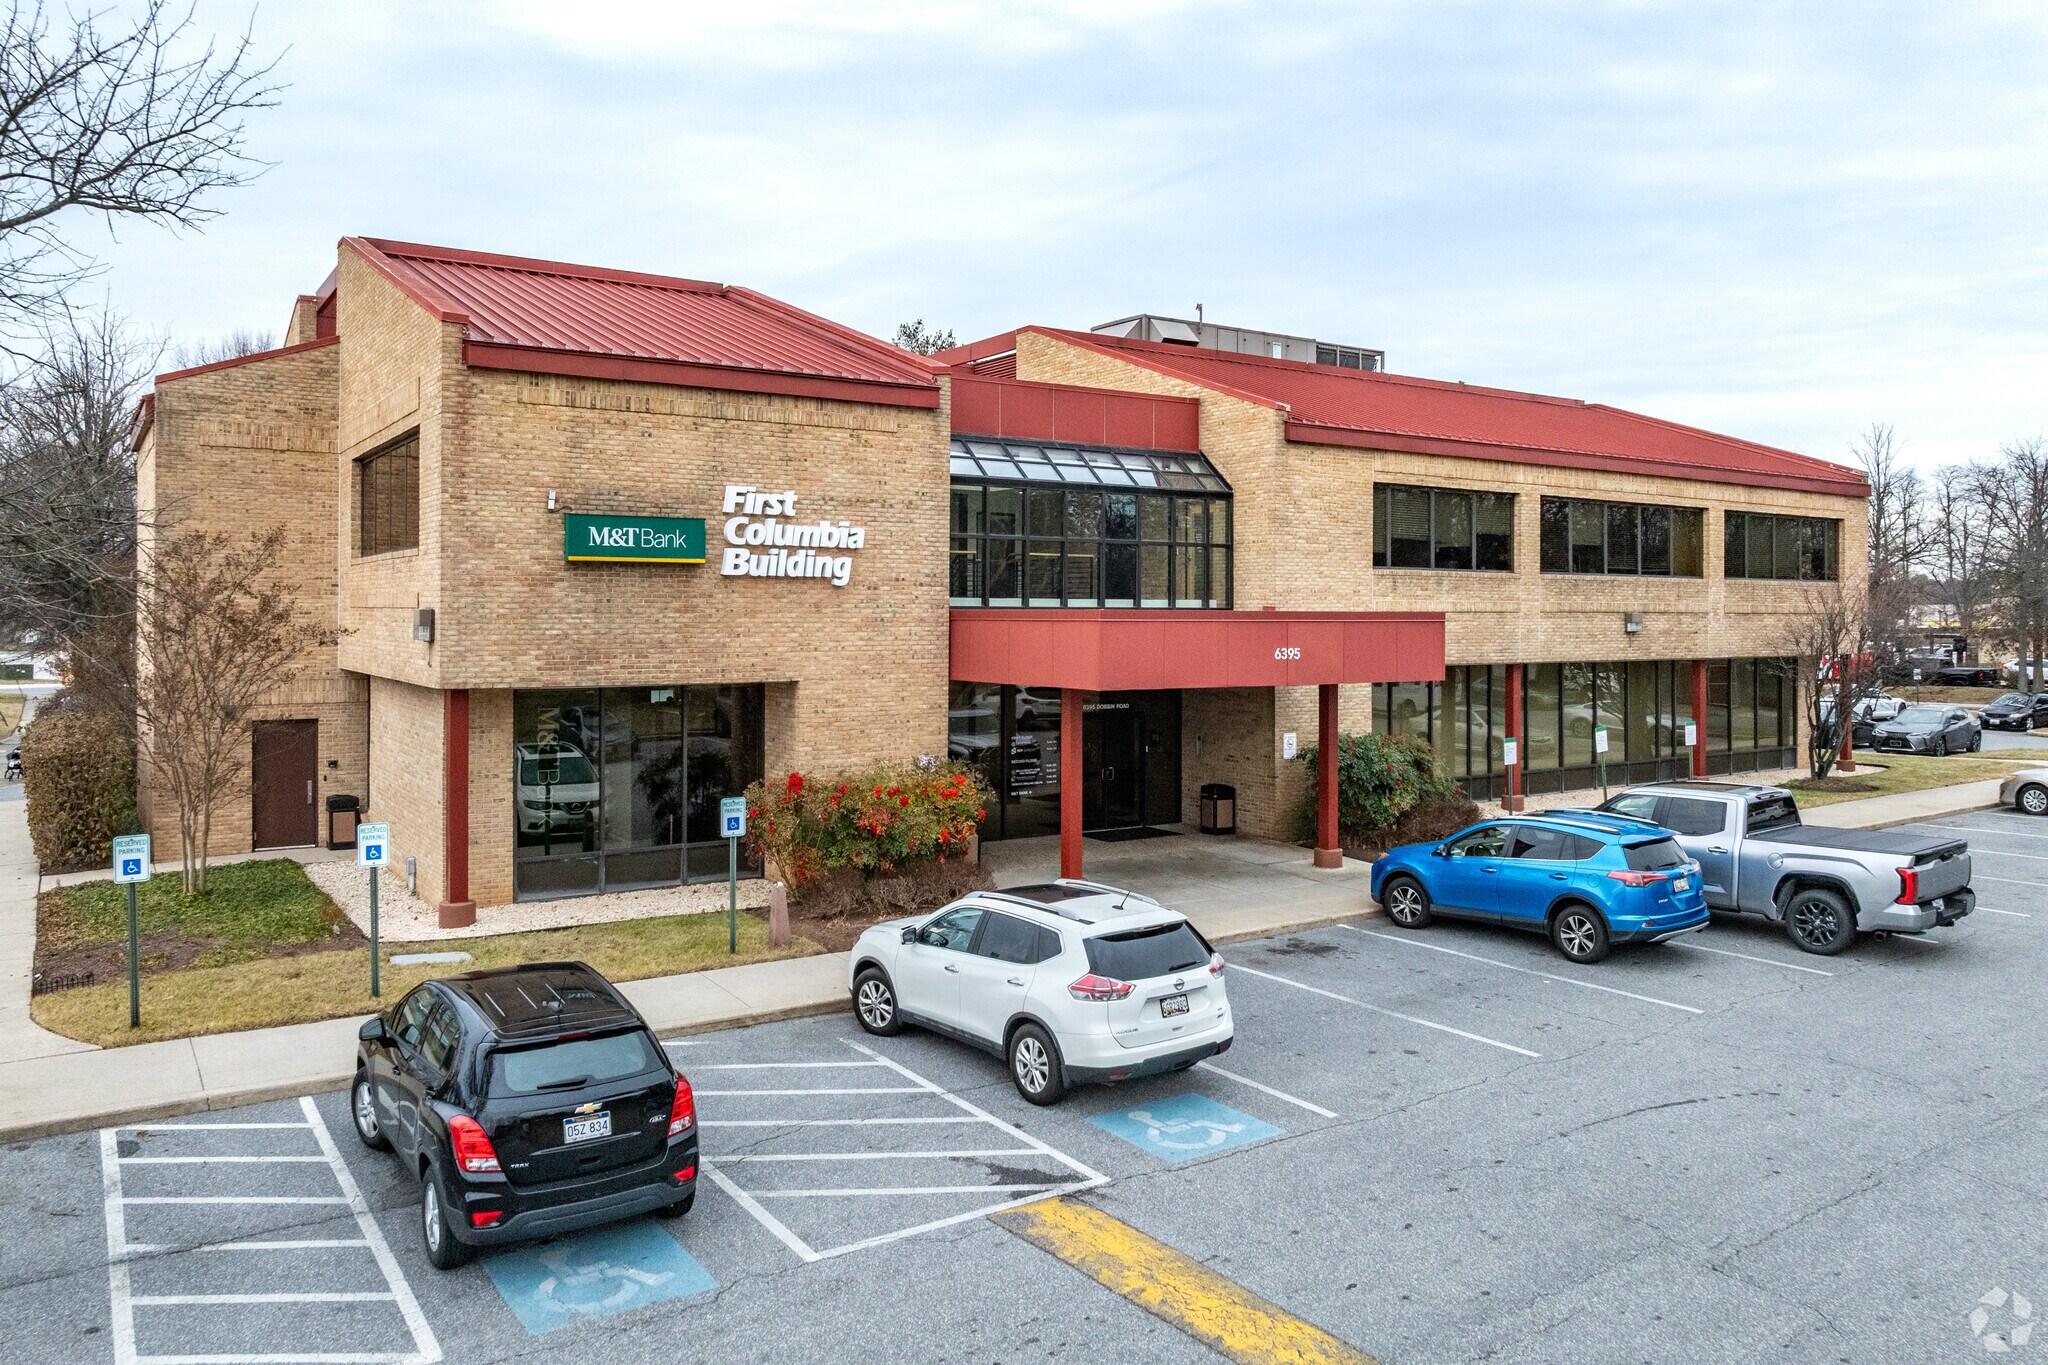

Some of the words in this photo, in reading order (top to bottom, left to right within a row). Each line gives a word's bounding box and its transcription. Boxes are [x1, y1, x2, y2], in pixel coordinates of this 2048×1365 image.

[722, 485, 798, 516] First
[588, 526, 639, 547] M&T
[641, 528, 687, 548] Bank
[723, 516, 865, 549] Columbia
[720, 547, 853, 587] Building
[1274, 647, 1301, 660] 6395
[537, 707, 561, 766] M&T
[360, 826, 387, 834] RESERVED
[116, 839, 147, 847] RESERVED
[118, 847, 146, 855] PARKING
[589, 1120, 608, 1133] 834
